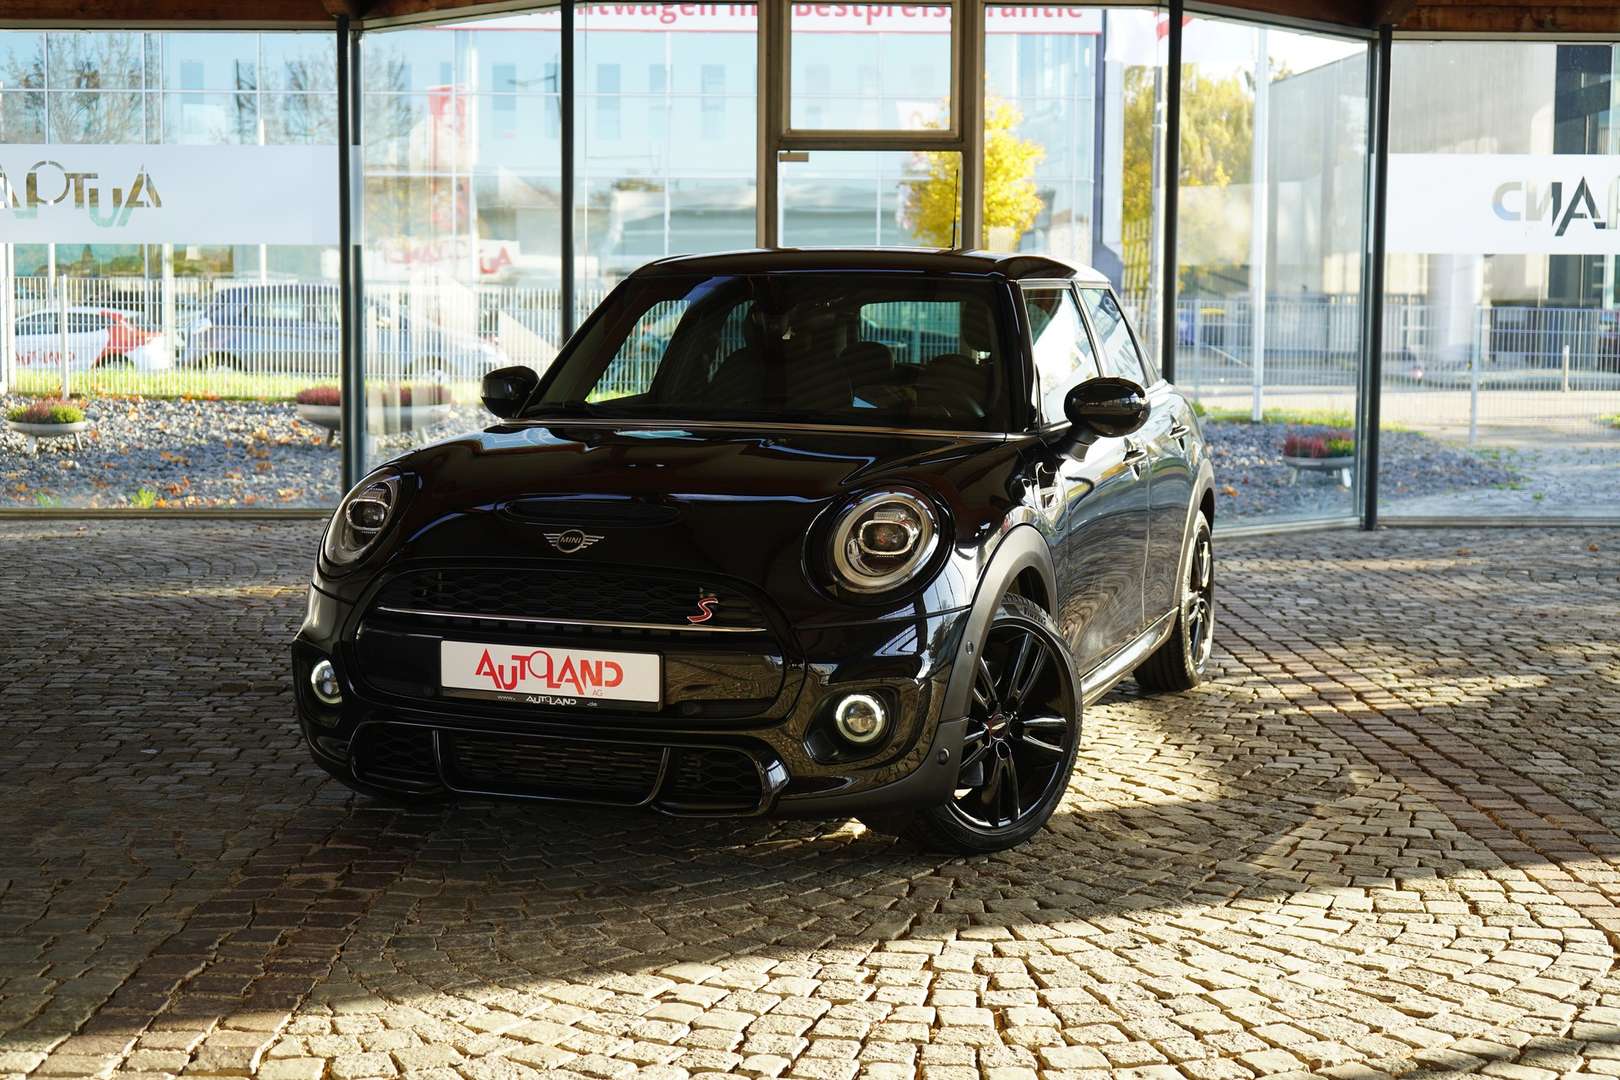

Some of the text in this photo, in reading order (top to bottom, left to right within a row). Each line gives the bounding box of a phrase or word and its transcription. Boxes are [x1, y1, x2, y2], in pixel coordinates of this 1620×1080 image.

[560, 536, 582, 544] MINI
[687, 597, 719, 623] S
[475, 648, 624, 695] AUTOLAND
[592, 689, 604, 697] AG
[526, 695, 577, 706] AUTOLAND
